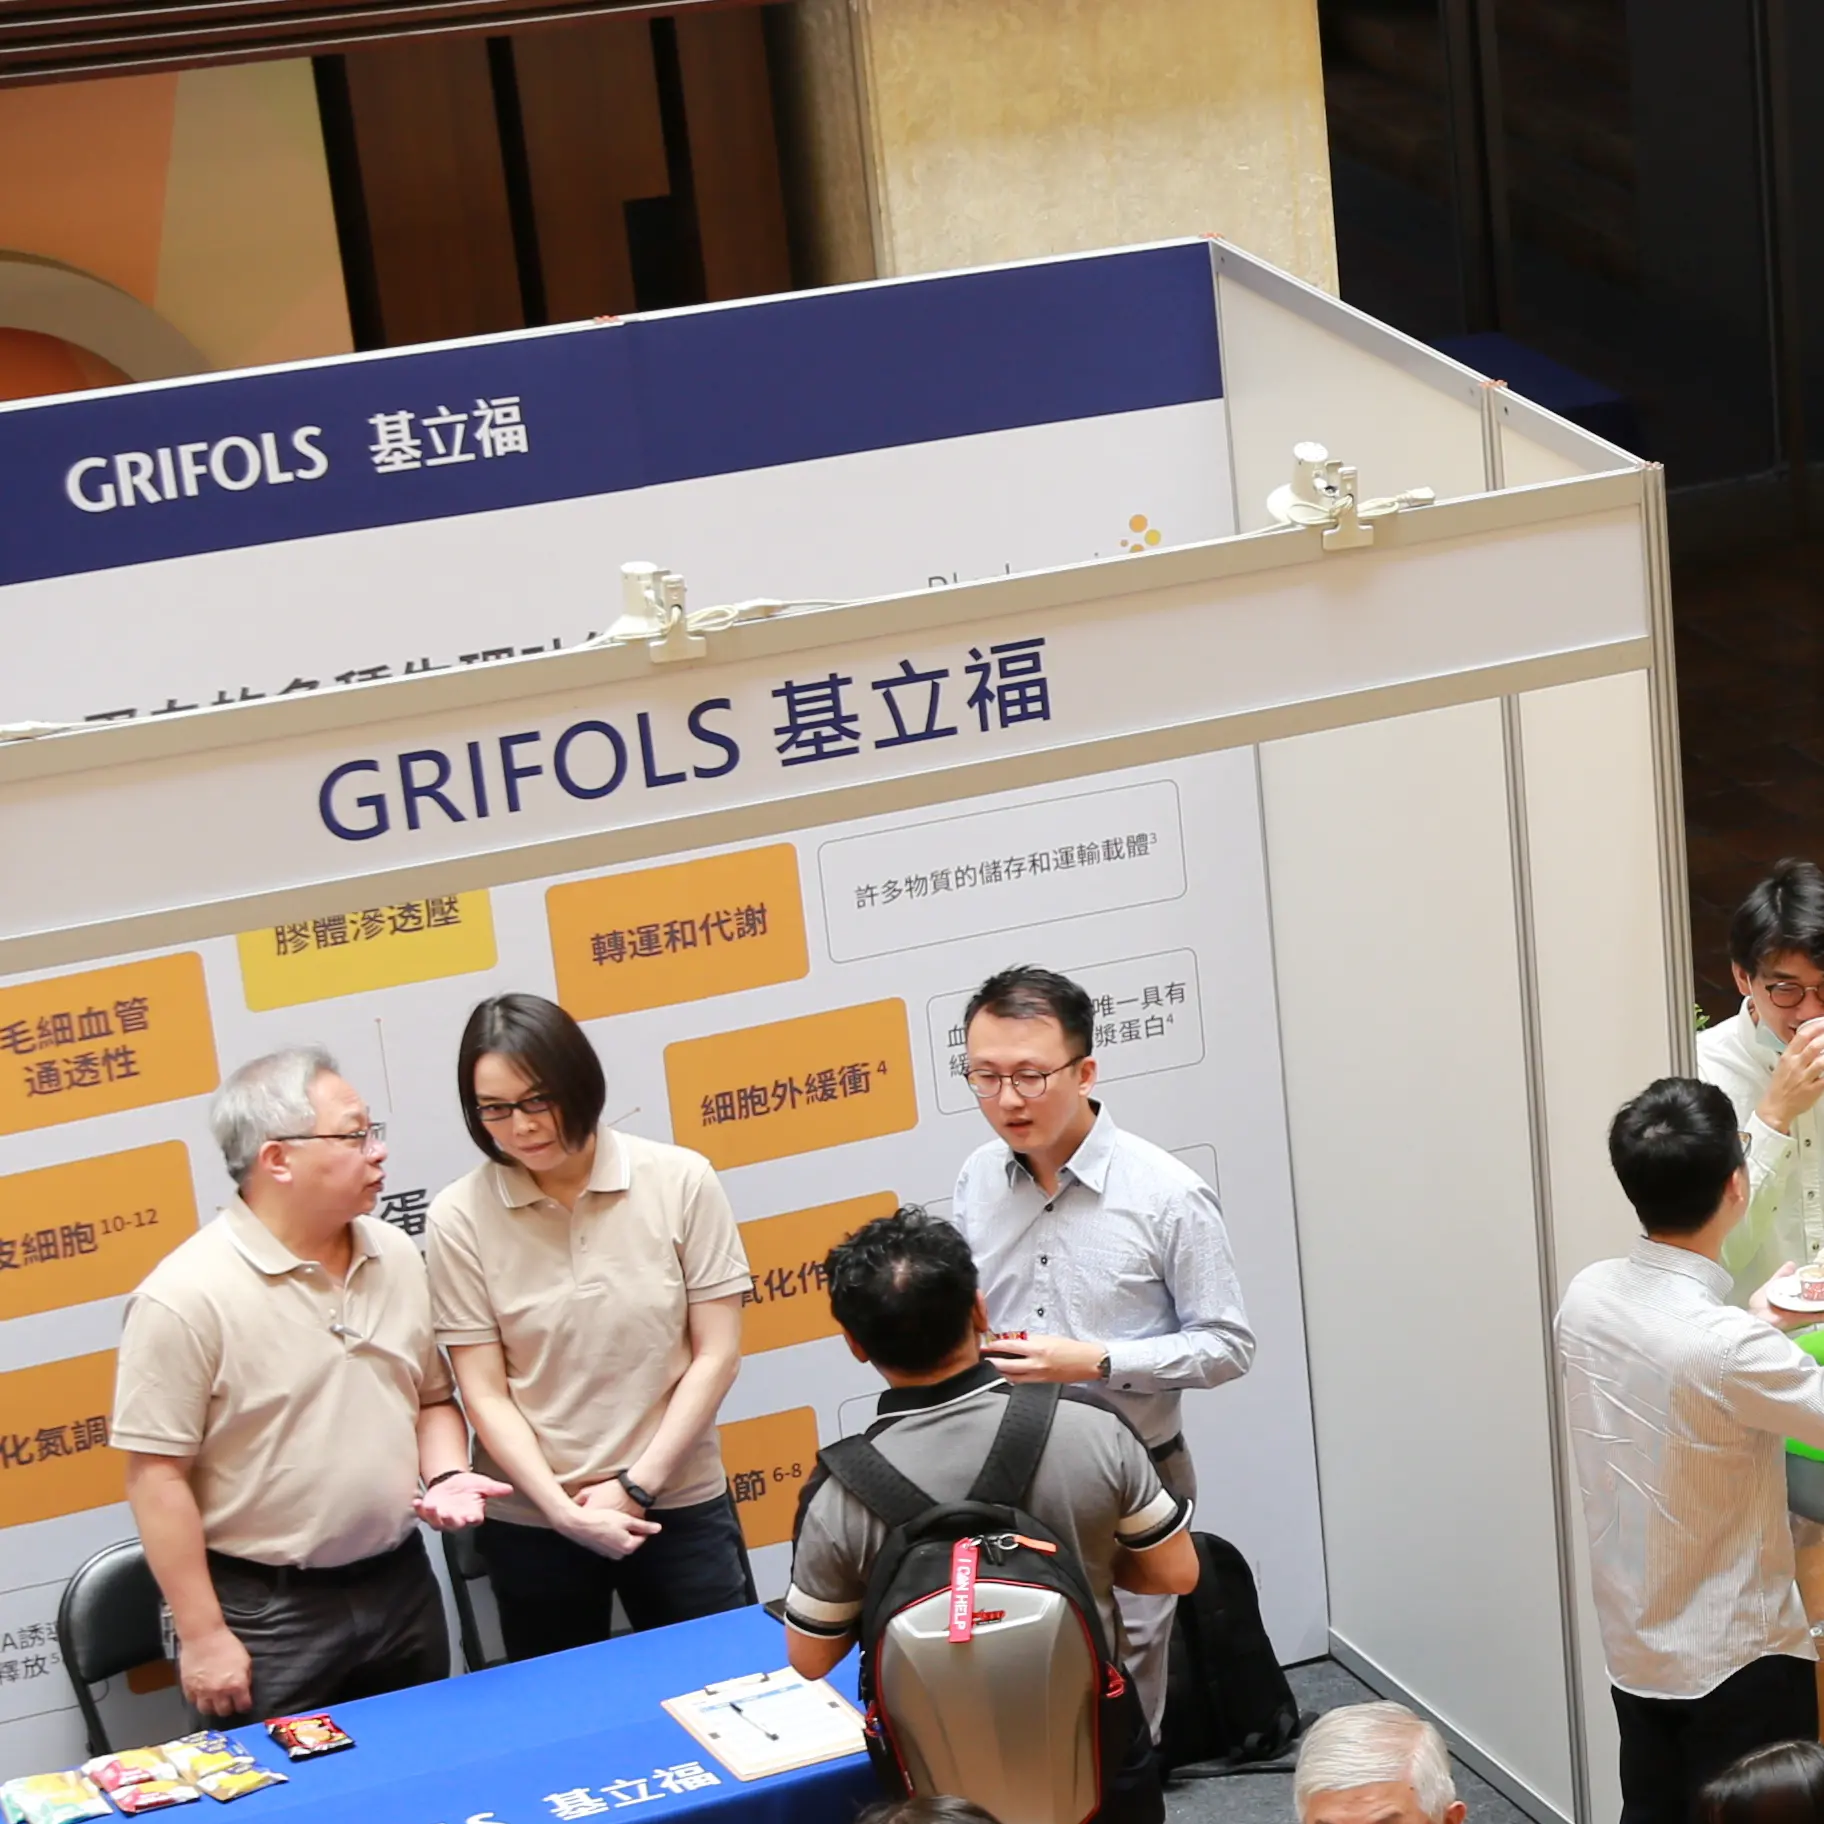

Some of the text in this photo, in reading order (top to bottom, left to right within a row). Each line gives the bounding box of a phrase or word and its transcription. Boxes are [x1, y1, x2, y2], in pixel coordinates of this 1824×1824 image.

[66, 396, 529, 514] GRIFOLS 基立福
[319, 637, 1052, 842] GRIFOLS 基立福
[591, 902, 768, 967] 轉運和代謝
[0, 997, 149, 1056] 毛細血管
[24, 1045, 140, 1097] 通透性
[700, 1061, 872, 1128] 細胞外緩衝
[955, 1565, 971, 1592] CAN
[952, 1593, 969, 1631] HELP
[543, 1760, 723, 1823] 基立福
